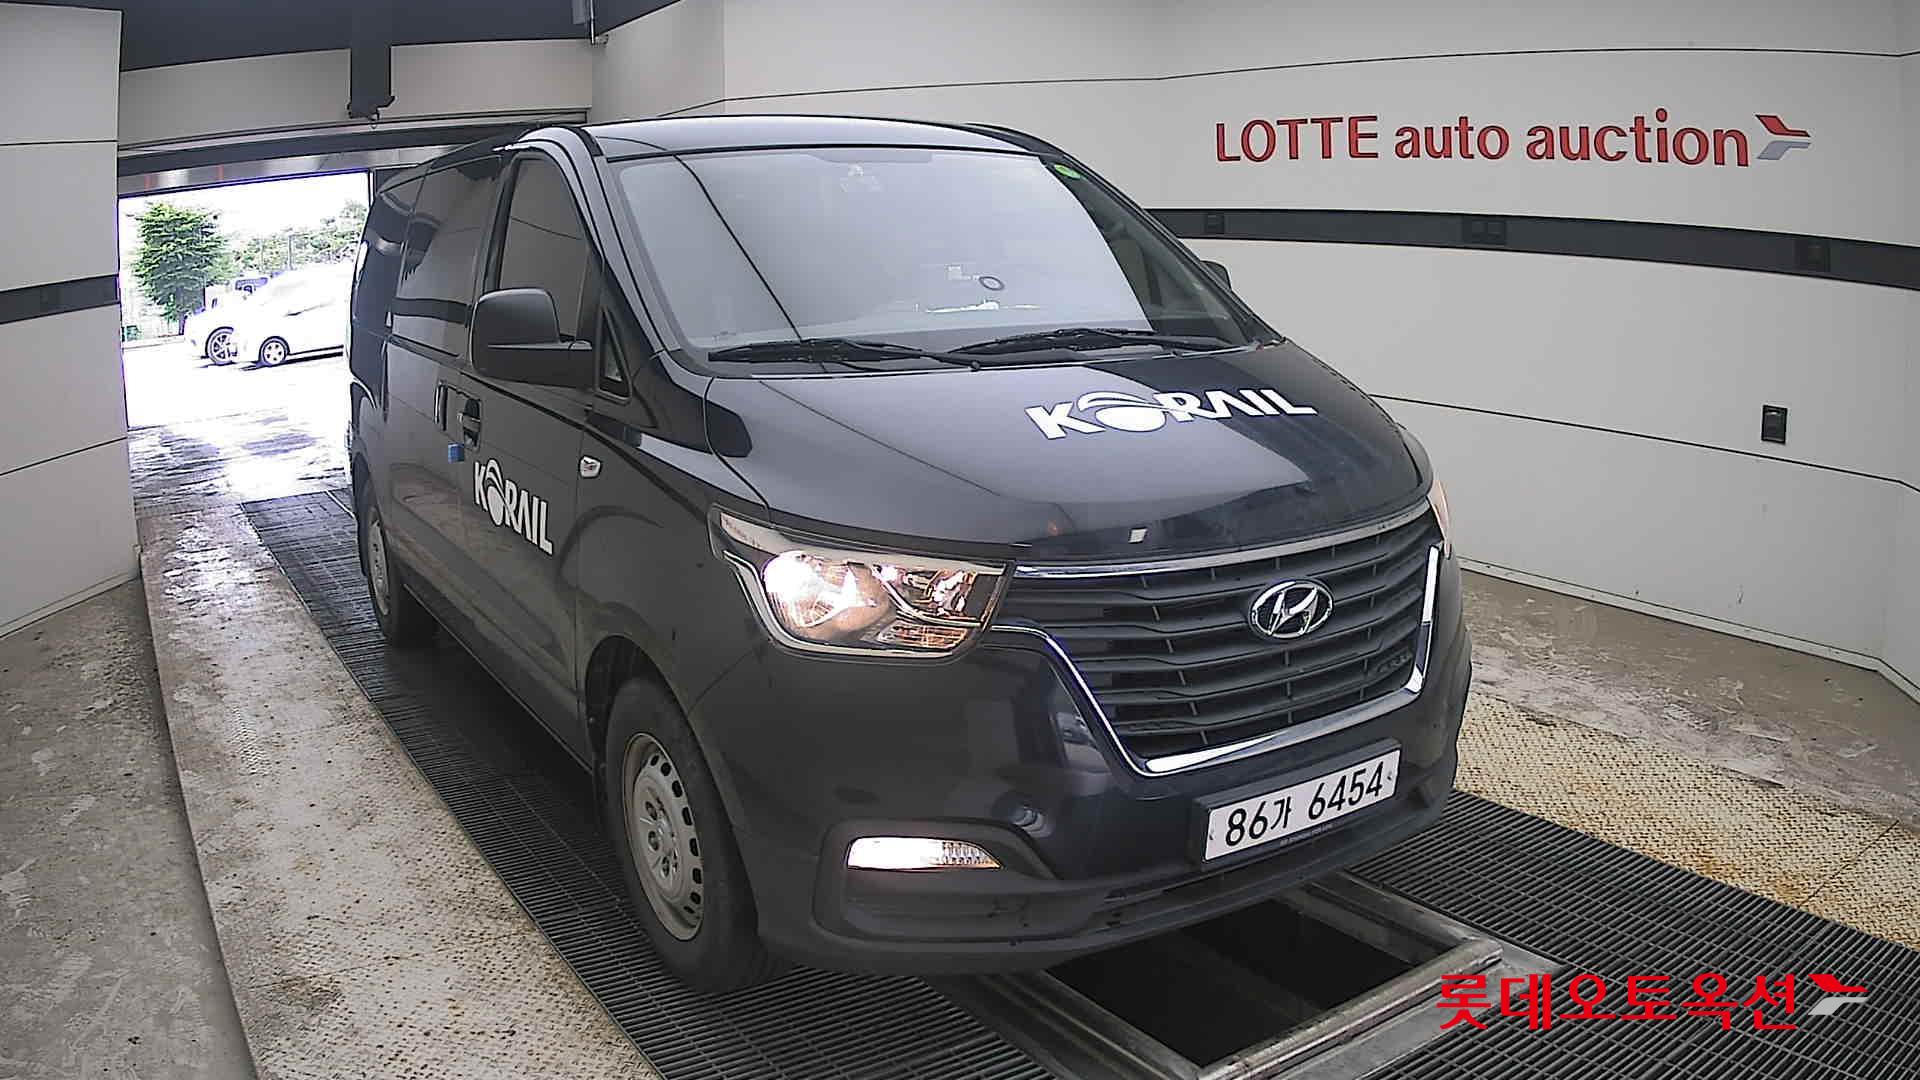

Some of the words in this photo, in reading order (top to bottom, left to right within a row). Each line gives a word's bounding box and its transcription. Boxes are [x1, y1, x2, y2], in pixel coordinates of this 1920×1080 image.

[1215, 115, 1378, 162] LOTTE
[1394, 116, 1510, 159] auto
[1525, 108, 1750, 167] auction
[1024, 389, 1318, 439] KORAIL
[474, 459, 553, 555] KORAIL
[1225, 795, 1292, 847] 86가
[1308, 761, 1384, 820] 6454
